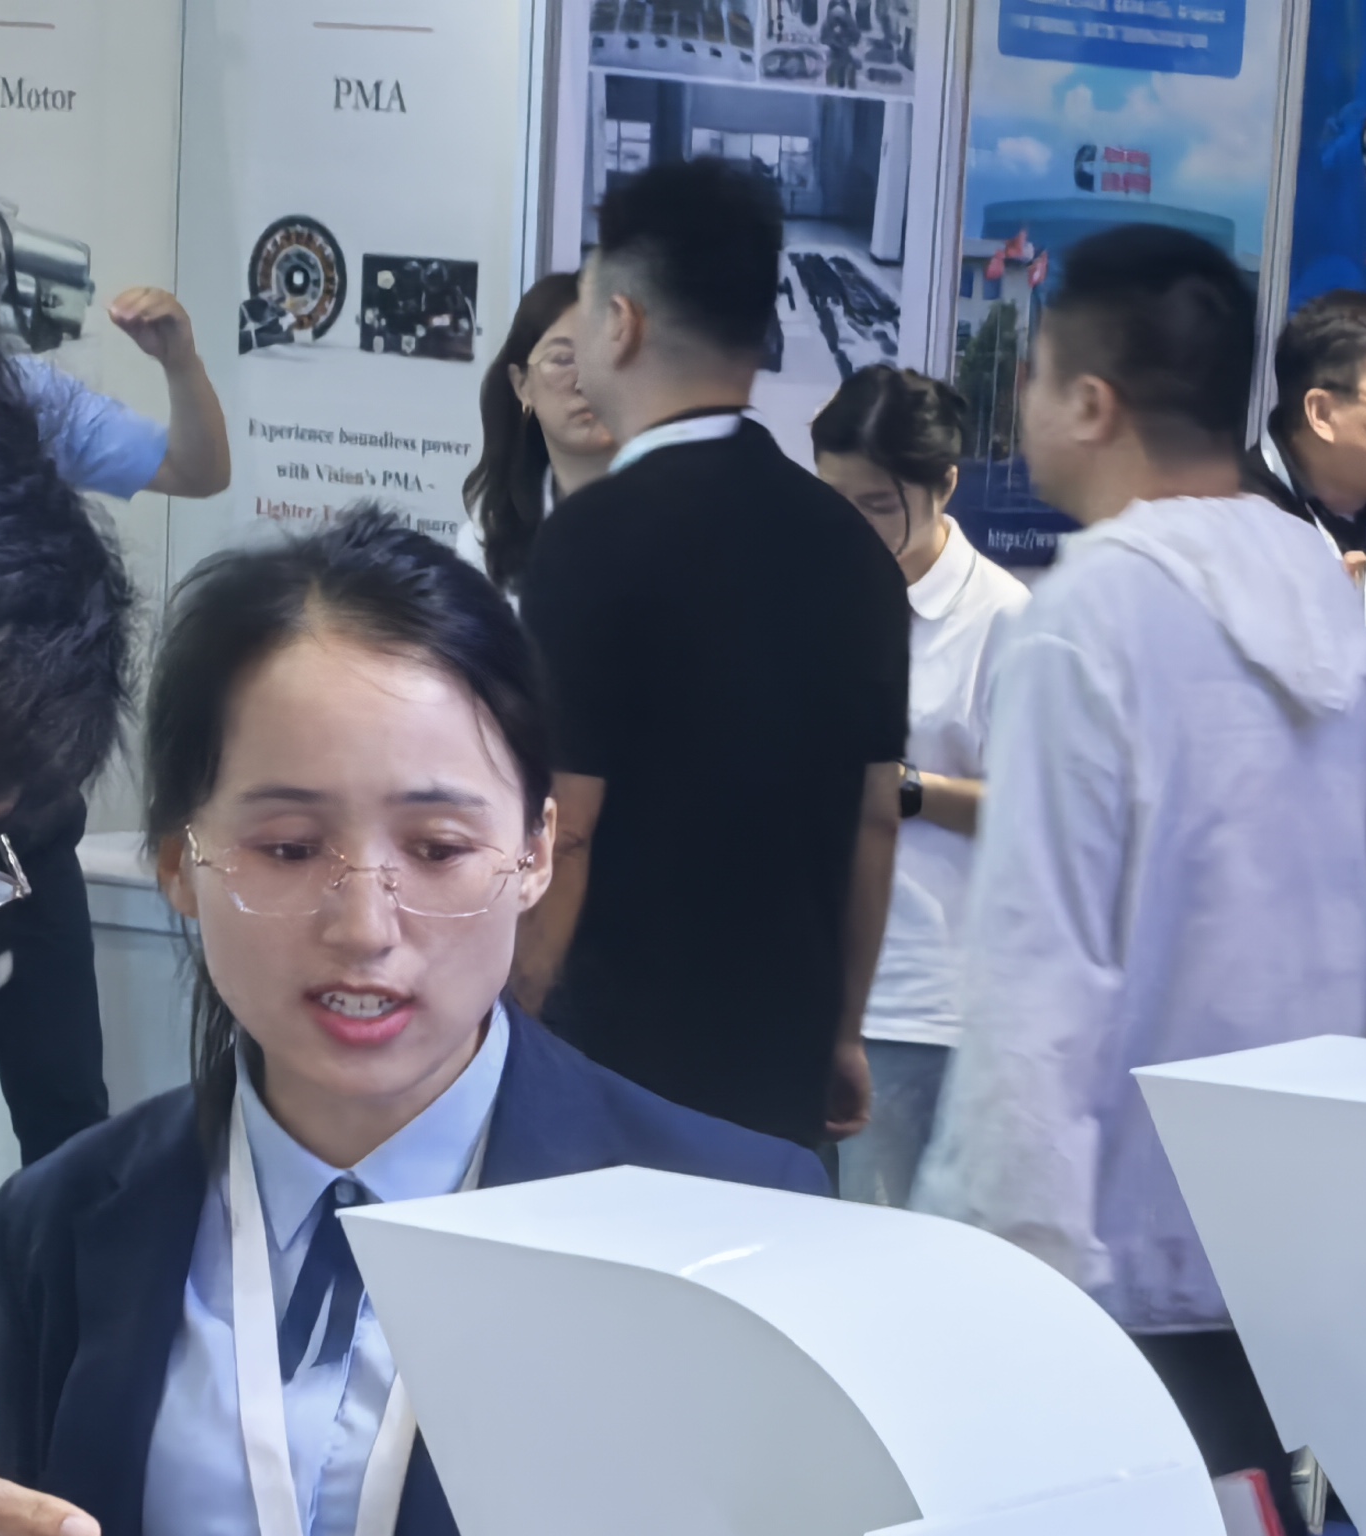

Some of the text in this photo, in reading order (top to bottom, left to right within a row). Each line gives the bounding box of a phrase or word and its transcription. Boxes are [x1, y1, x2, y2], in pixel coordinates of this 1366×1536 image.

[0, 77, 77, 112] Motor
[333, 77, 408, 115] PMA
[421, 437, 472, 458] power
[276, 463, 310, 481] with
[382, 470, 423, 493] PMA
